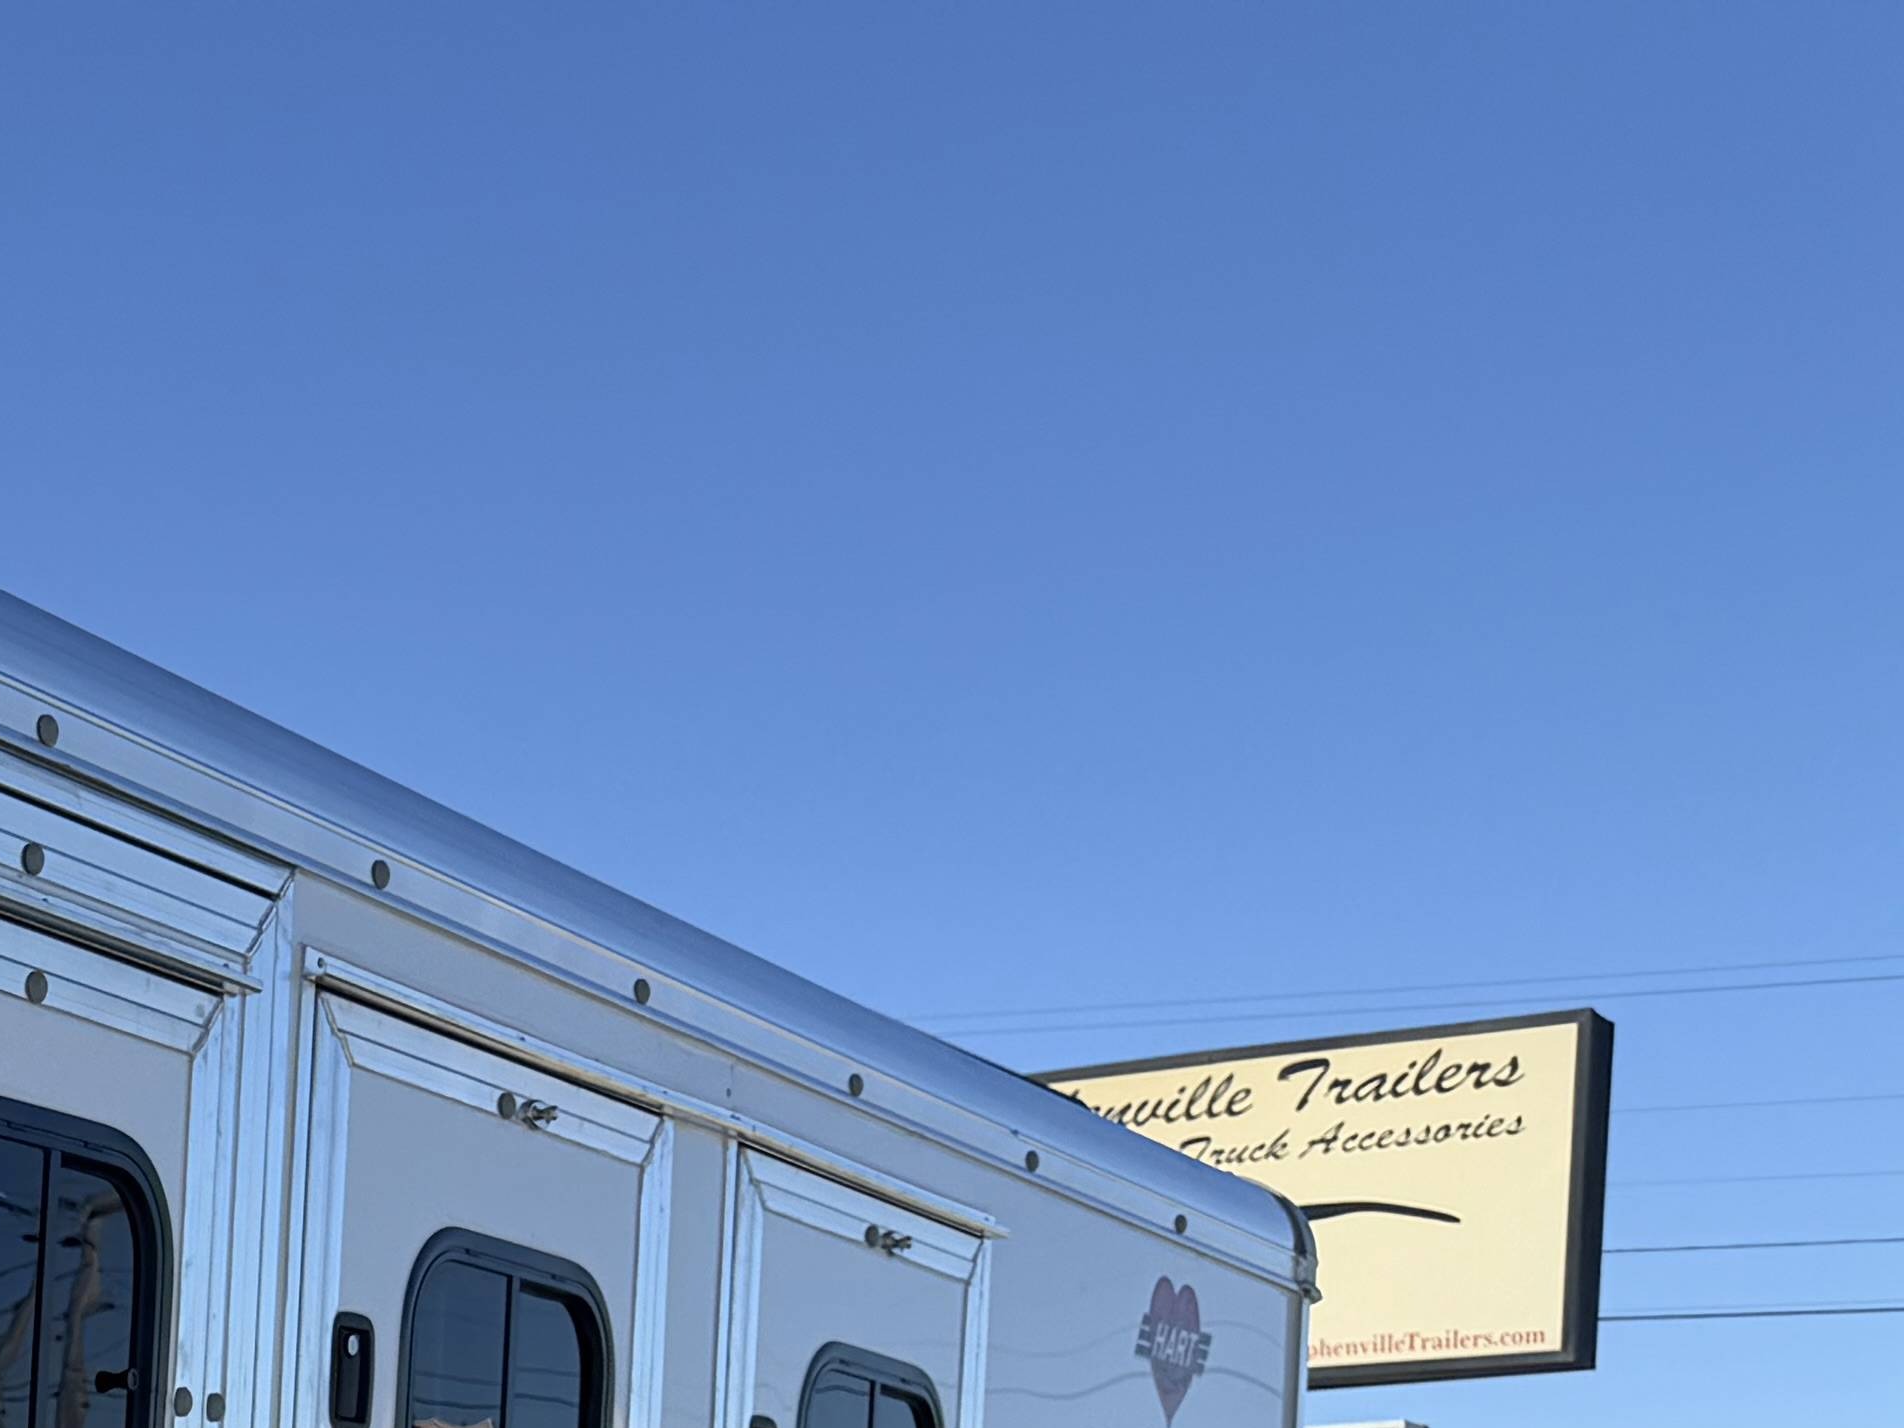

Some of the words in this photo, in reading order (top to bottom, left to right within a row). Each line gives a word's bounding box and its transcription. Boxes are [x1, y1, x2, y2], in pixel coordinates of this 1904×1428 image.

[1277, 1048, 1525, 1112] Trailers
[1178, 1128, 1290, 1165] Truck
[1298, 1114, 1526, 1159] Accessories
[1151, 1321, 1199, 1367] HART
